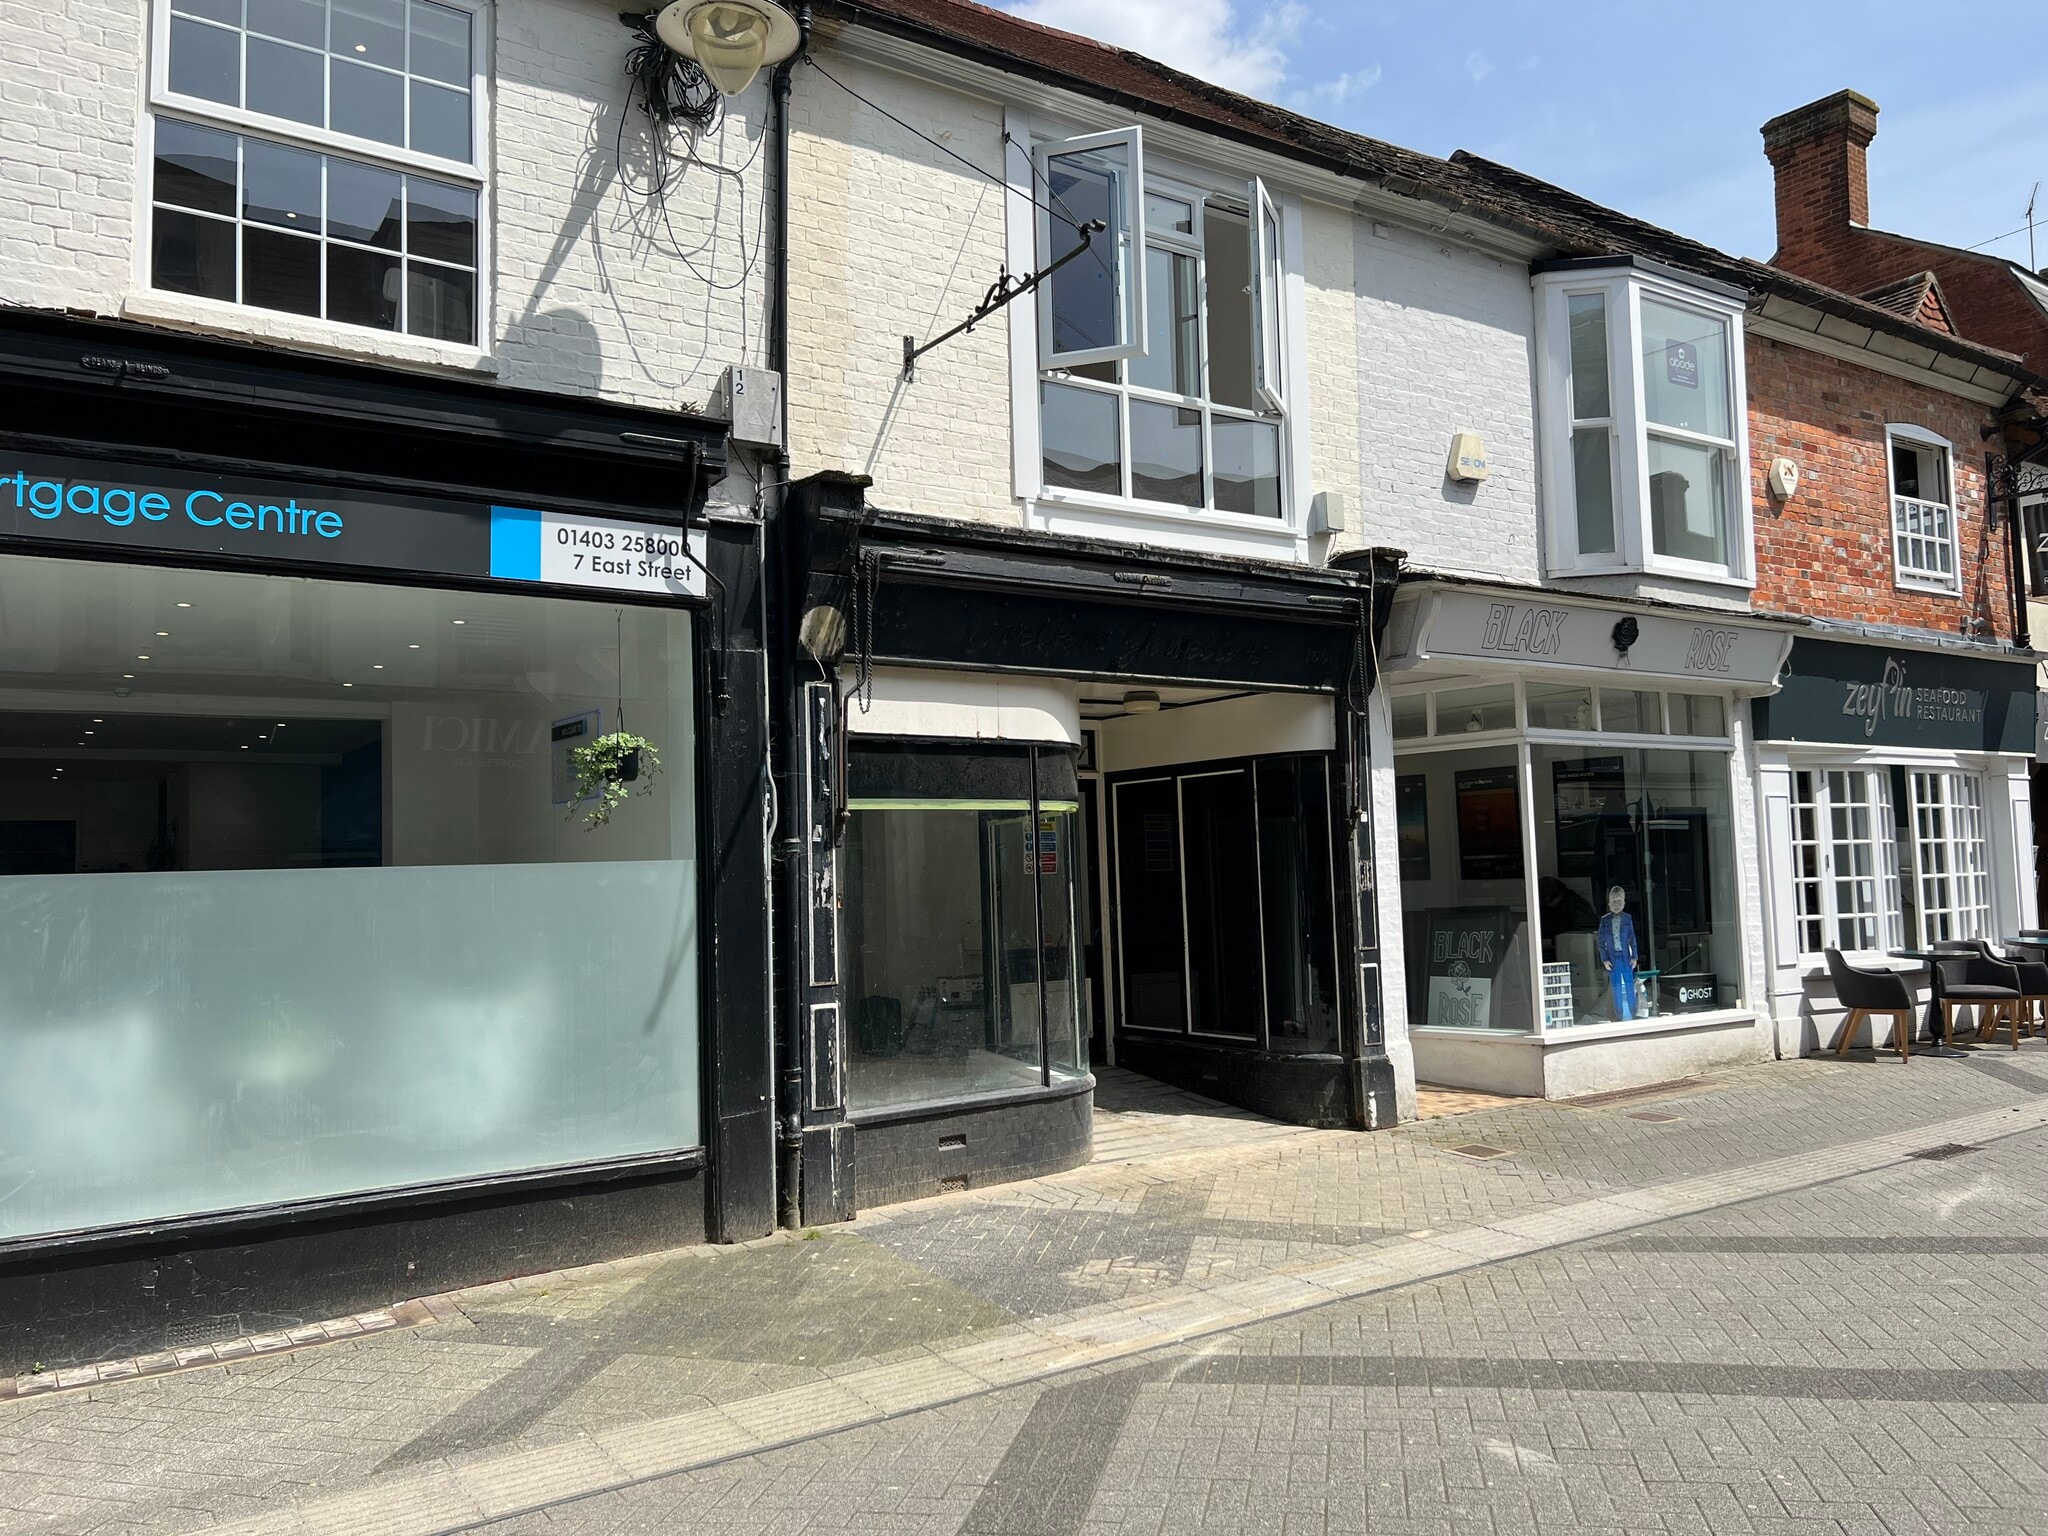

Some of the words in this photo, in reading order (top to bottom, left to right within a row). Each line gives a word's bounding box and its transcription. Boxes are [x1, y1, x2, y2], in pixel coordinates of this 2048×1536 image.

[736, 369, 743, 381] 1
[735, 383, 744, 395] 2
[1460, 456, 1486, 469] SEOM
[185, 489, 344, 538] Centre
[557, 527, 615, 550] 01403
[573, 554, 584, 570] 7
[592, 556, 631, 575] East
[637, 560, 692, 581] Street
[1481, 603, 1569, 655] BLACK
[1684, 628, 1739, 673] ROSE
[1916, 687, 1967, 705] SEAFOOD
[1916, 705, 1982, 723] RESTAURANT
[1433, 931, 1494, 963] BLACK
[1687, 987, 1713, 1000] GHOST
[1438, 991, 1483, 1026] ROSE
